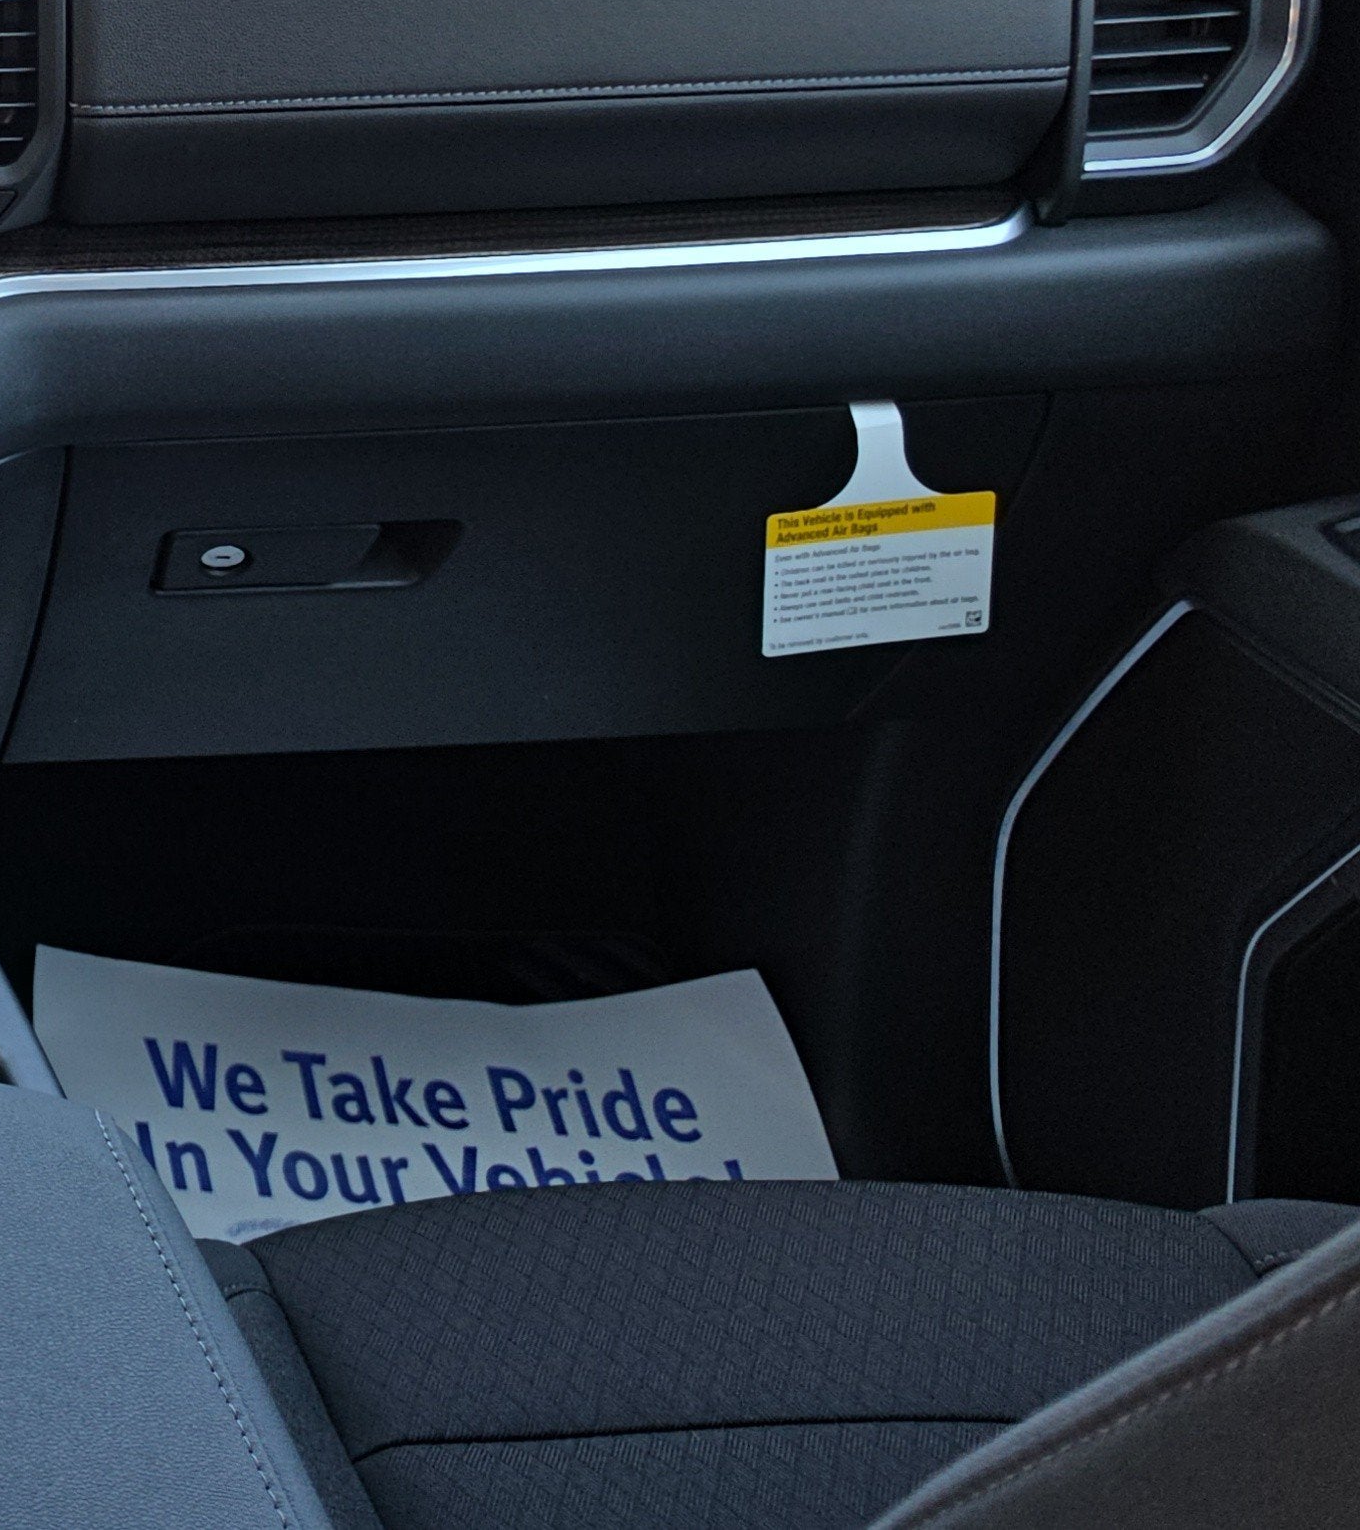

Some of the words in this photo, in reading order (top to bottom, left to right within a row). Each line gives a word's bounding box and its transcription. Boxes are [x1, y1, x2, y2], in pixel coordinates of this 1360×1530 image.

[776, 528, 829, 543] Advanced
[832, 525, 847, 535] Air
[850, 523, 878, 536] Bags
[778, 518, 799, 528] This
[802, 512, 842, 526] Vehicle
[844, 511, 854, 521] is
[857, 504, 908, 520] Equipped
[912, 502, 936, 513] with
[143, 1036, 269, 1115] We
[281, 1050, 470, 1131] Take
[485, 1066, 704, 1143] Pride
[134, 1121, 214, 1193] In
[226, 1127, 410, 1206] Your
